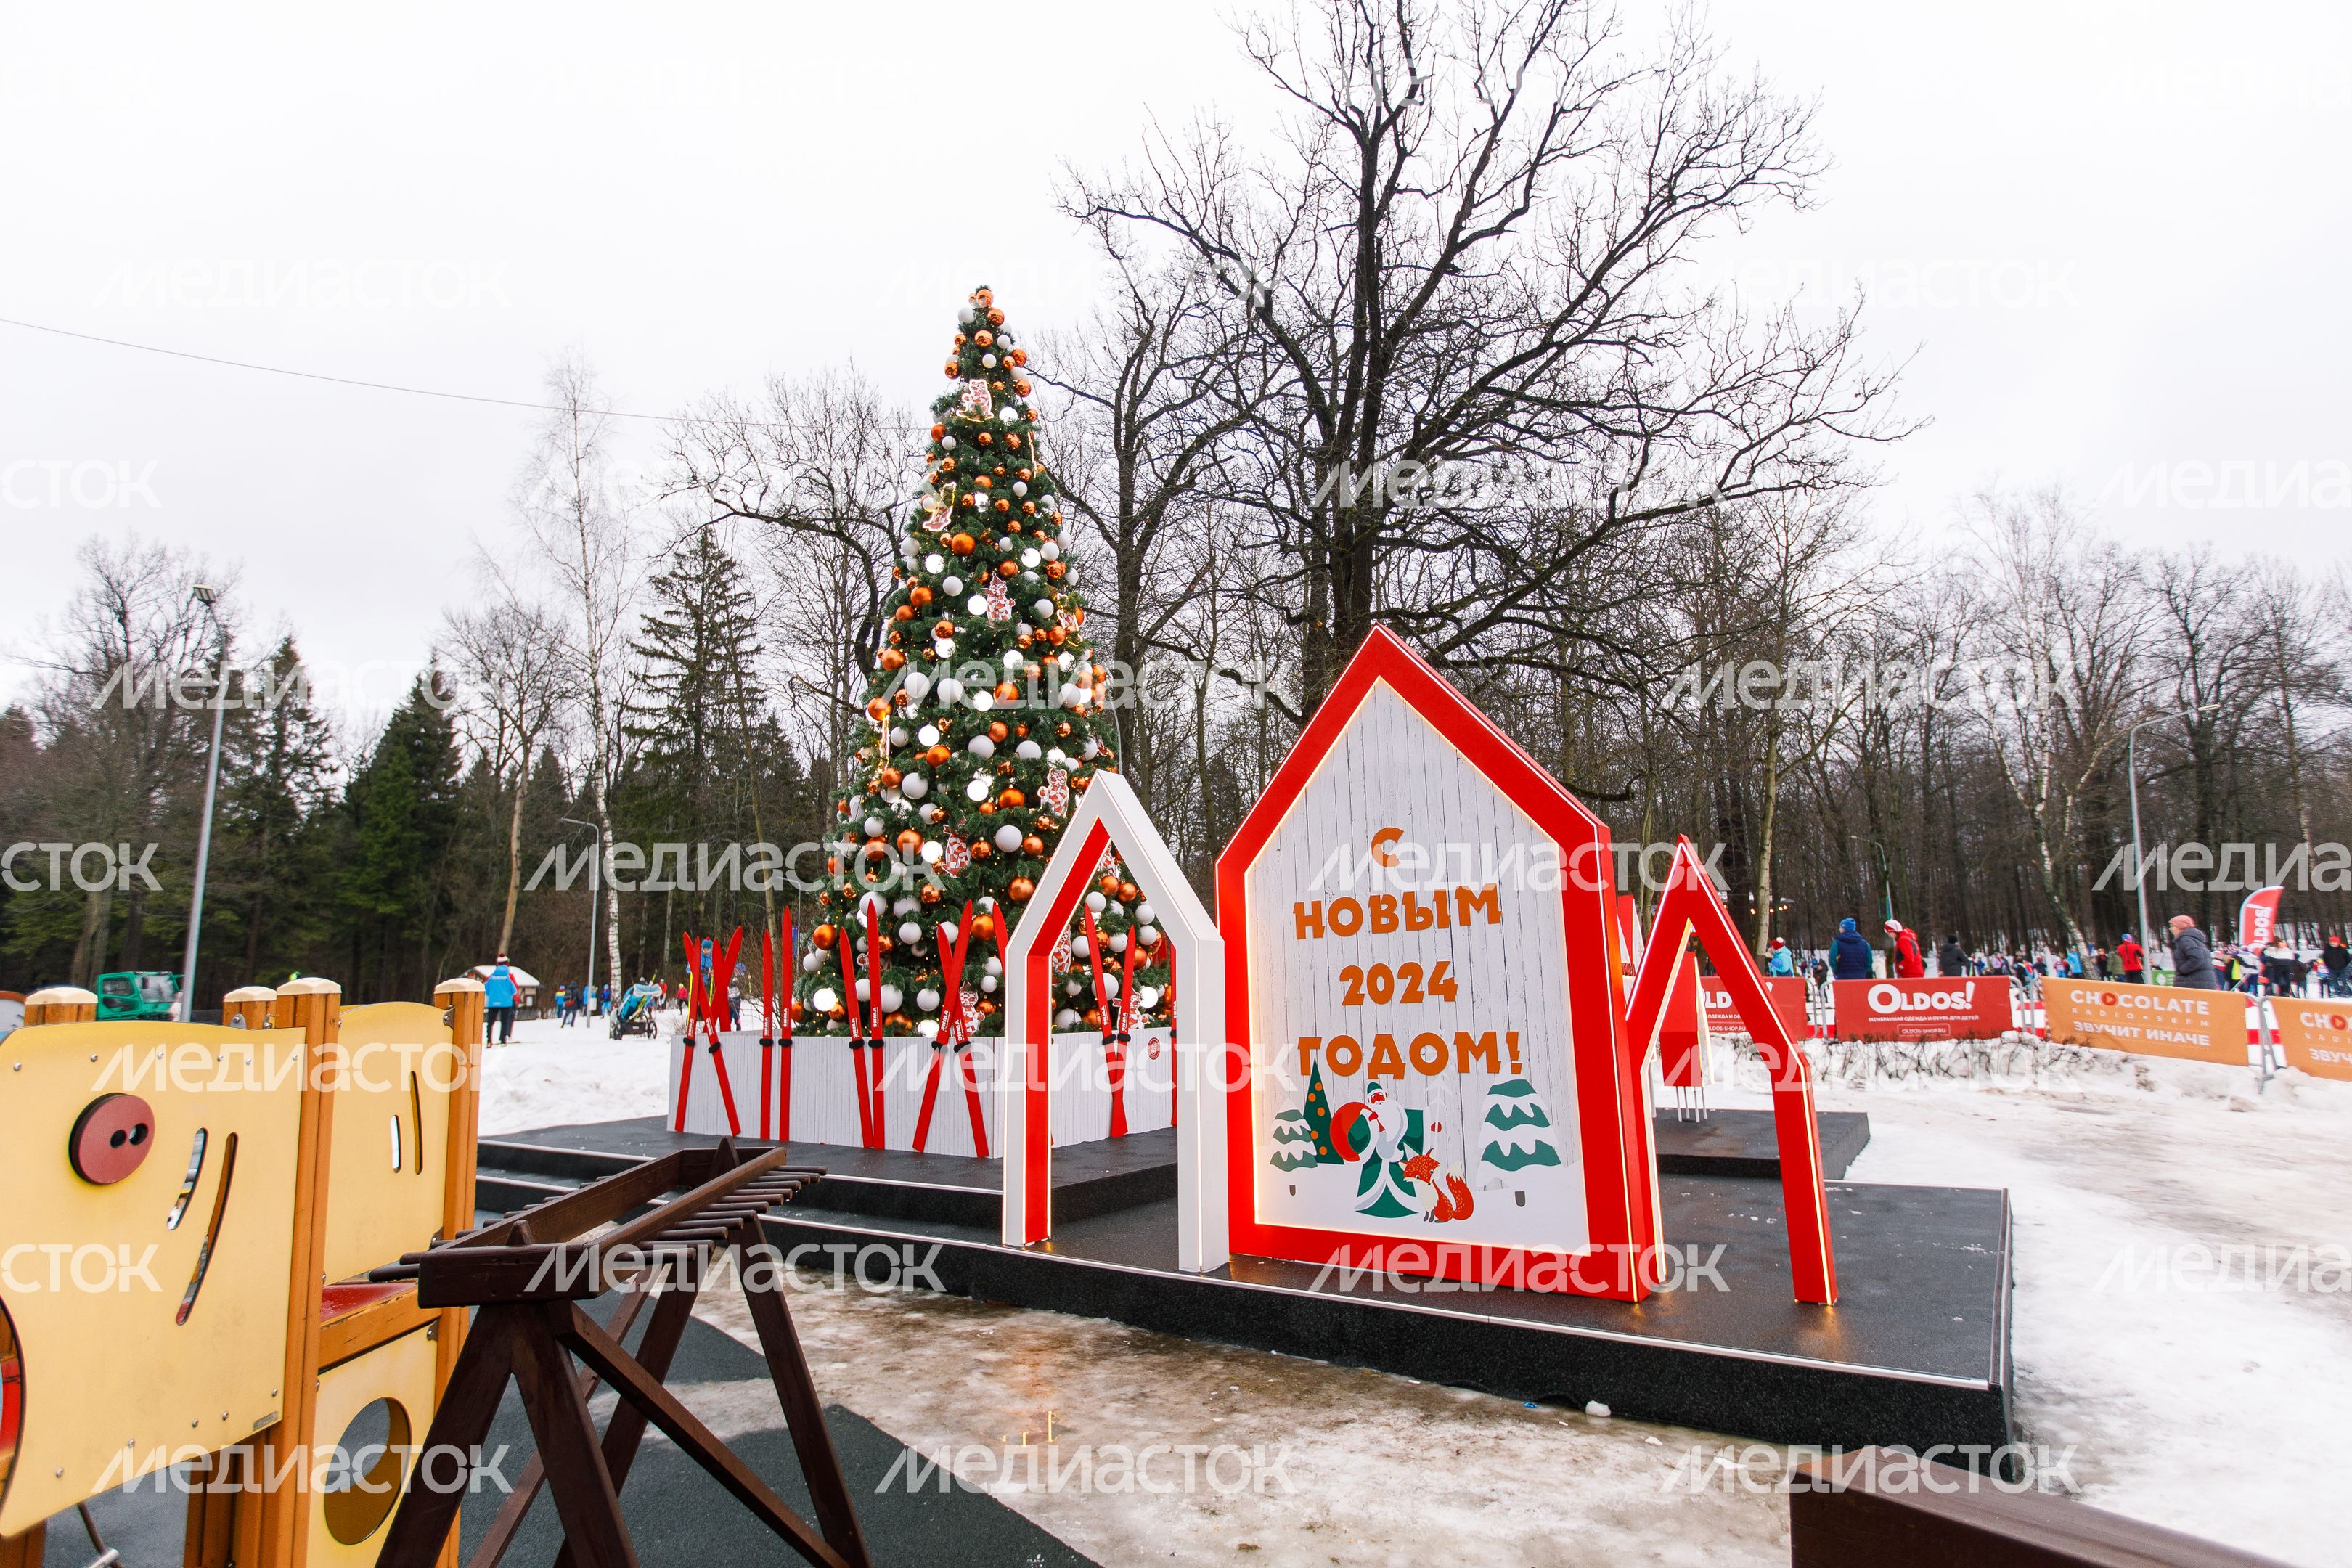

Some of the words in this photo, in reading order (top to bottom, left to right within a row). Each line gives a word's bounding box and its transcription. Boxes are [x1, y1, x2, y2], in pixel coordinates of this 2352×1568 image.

[1371, 827, 1404, 867] С
[1293, 883, 1502, 940] НОВЫМ
[1339, 960, 1458, 1005] 2024
[2070, 989, 2210, 1016] CHOCOLATE
[2073, 1021, 2140, 1038] ЗВУЧИТ
[2146, 1029, 2211, 1046] ИНАЧЕ
[1297, 1031, 1522, 1080] ГОДОМ!
